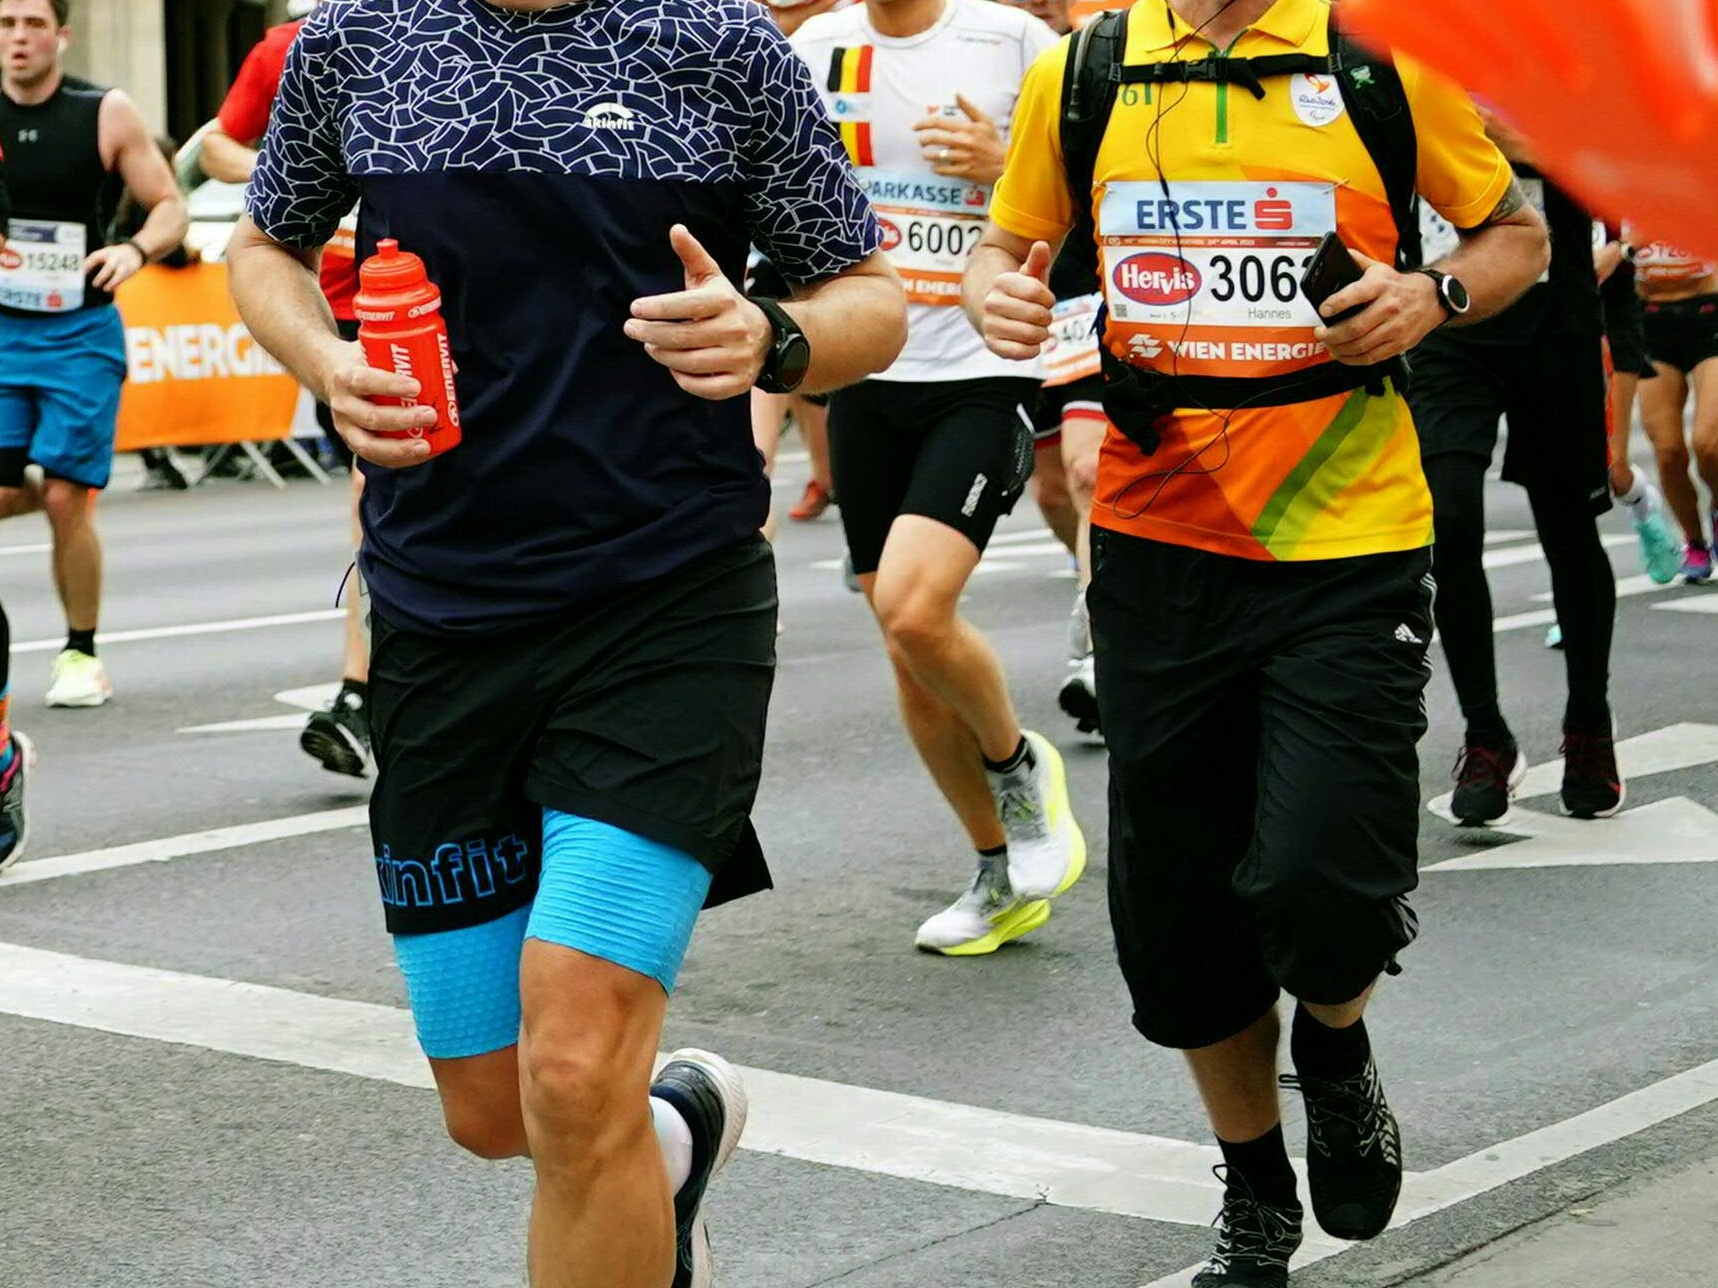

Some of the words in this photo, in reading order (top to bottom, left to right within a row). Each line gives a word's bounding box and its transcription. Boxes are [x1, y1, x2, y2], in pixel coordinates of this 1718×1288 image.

[1137, 200, 1248, 231] ERSTE
[1121, 264, 1195, 295] Hervis
[1209, 255, 1315, 303] 306
[1248, 307, 1292, 320] Hannes
[125, 323, 287, 384] ENERG
[436, 334, 460, 403] ENERVIT
[1167, 340, 1227, 361] WIEN
[375, 834, 528, 906] infit
